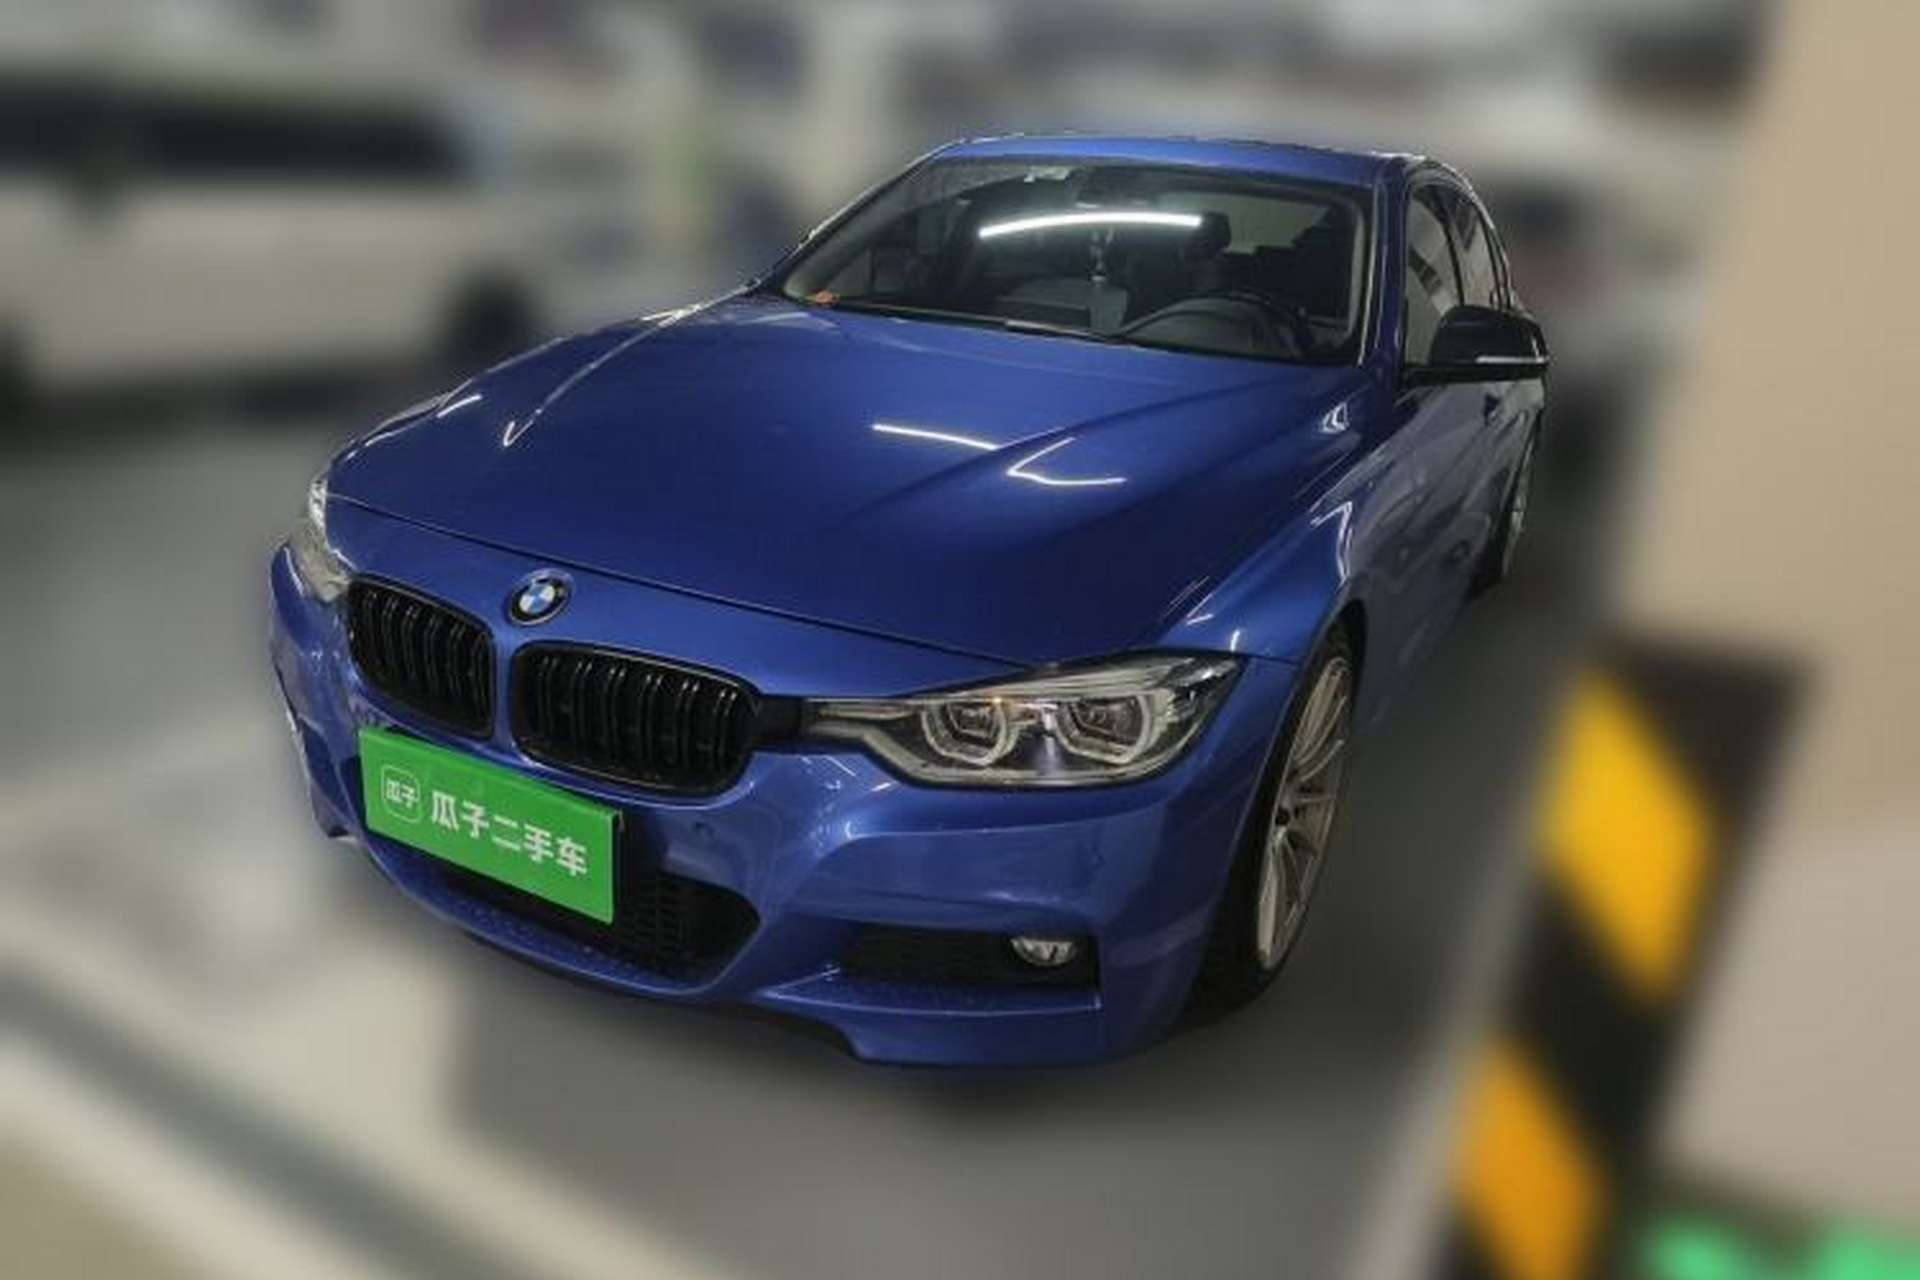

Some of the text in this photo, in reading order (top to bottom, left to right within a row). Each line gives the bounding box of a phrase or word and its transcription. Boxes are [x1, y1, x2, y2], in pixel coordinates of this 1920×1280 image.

[431, 790, 587, 876] 瓜子二手车
